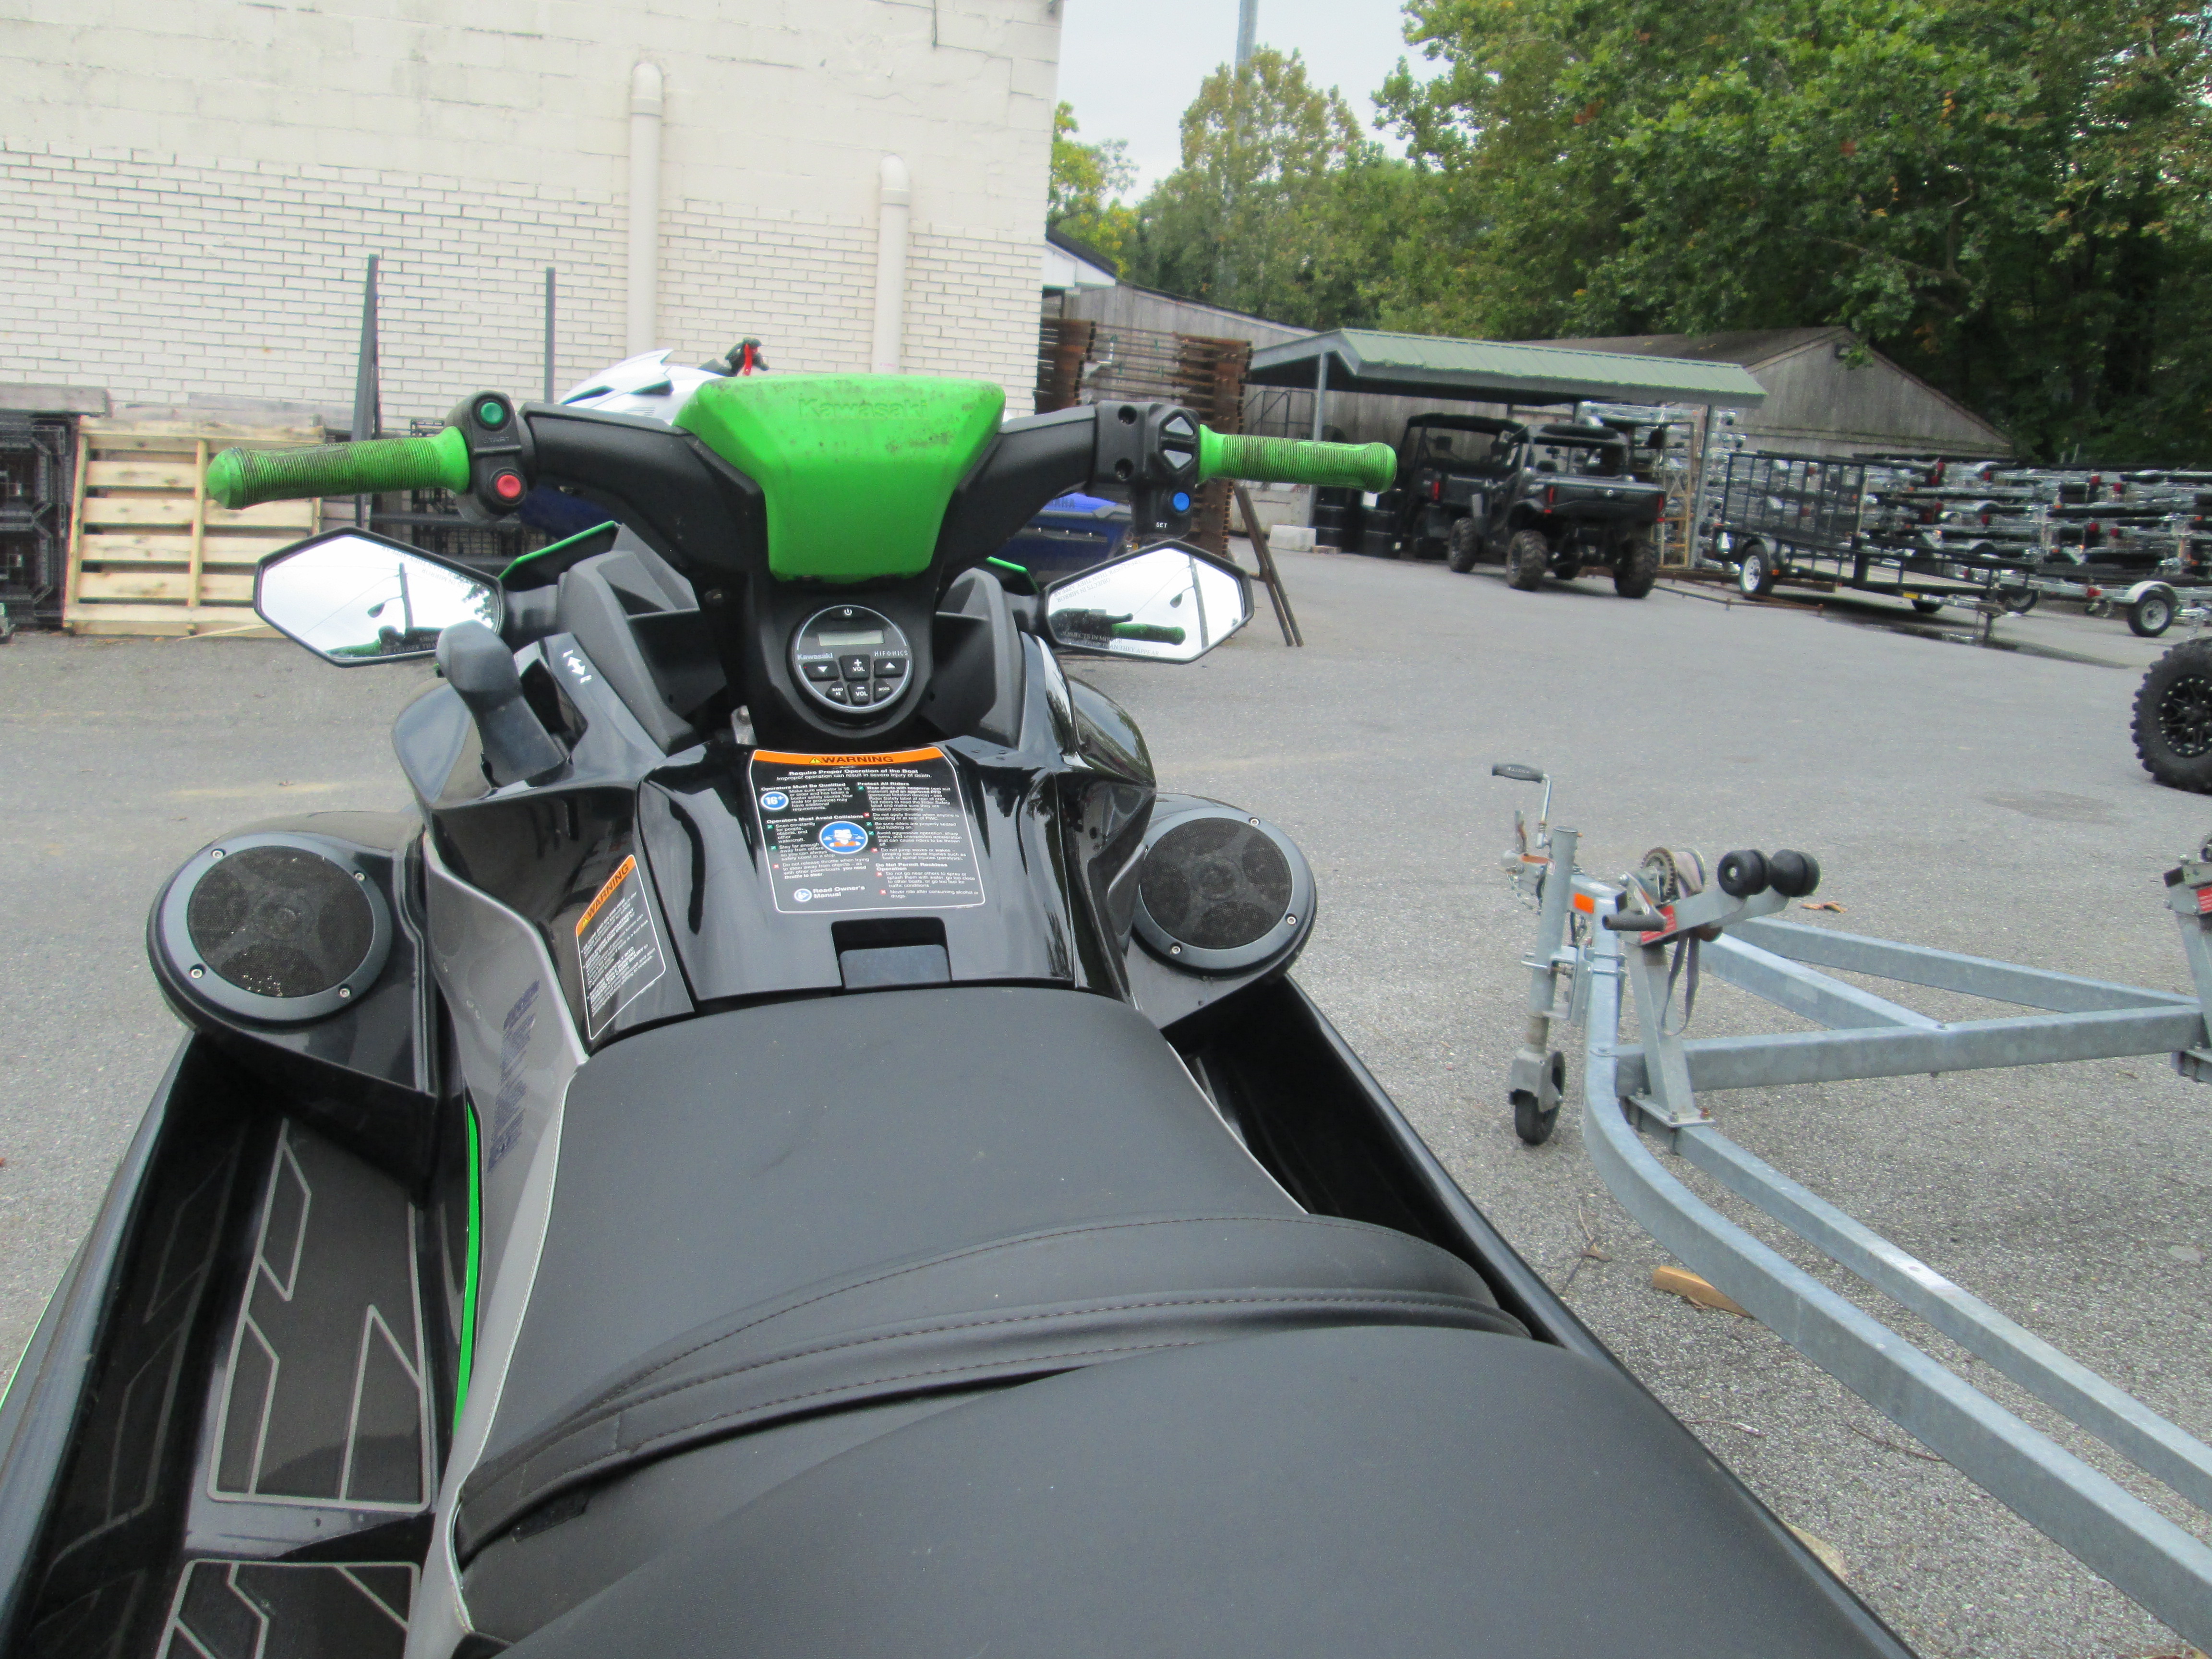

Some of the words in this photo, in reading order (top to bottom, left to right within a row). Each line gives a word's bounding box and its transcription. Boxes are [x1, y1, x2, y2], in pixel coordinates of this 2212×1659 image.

[798, 399, 926, 418] Kawasaki
[1088, 578, 1111, 590] OBJECTS
[1057, 590, 1079, 602] MIRROR
[765, 795, 783, 805] 16+
[588, 864, 629, 917] WARNING
[629, 947, 643, 962] INJURY
